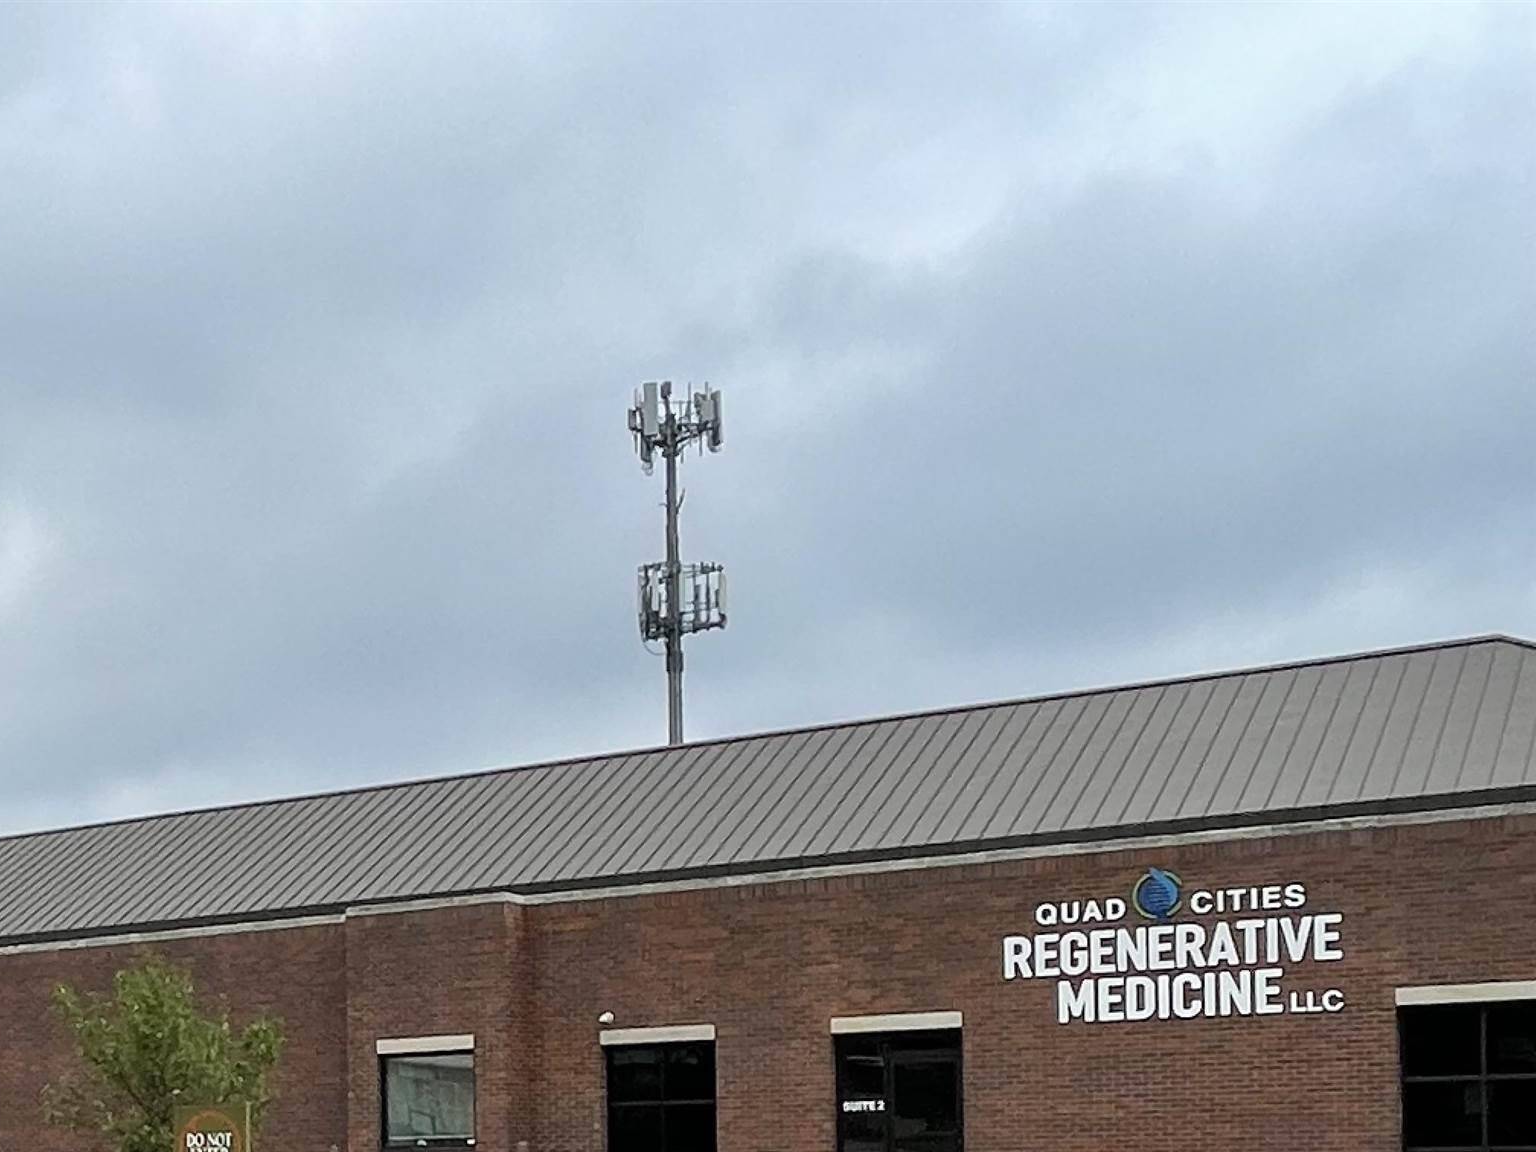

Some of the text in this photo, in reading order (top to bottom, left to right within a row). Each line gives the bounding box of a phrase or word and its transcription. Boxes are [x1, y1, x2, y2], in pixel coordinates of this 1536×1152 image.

[1035, 884, 1306, 925] QUAD CITIES
[1003, 913, 1343, 980] REGENERATIVE
[1057, 968, 1344, 1024] MEDICINE LLC
[186, 1132, 232, 1148] DO NOT
